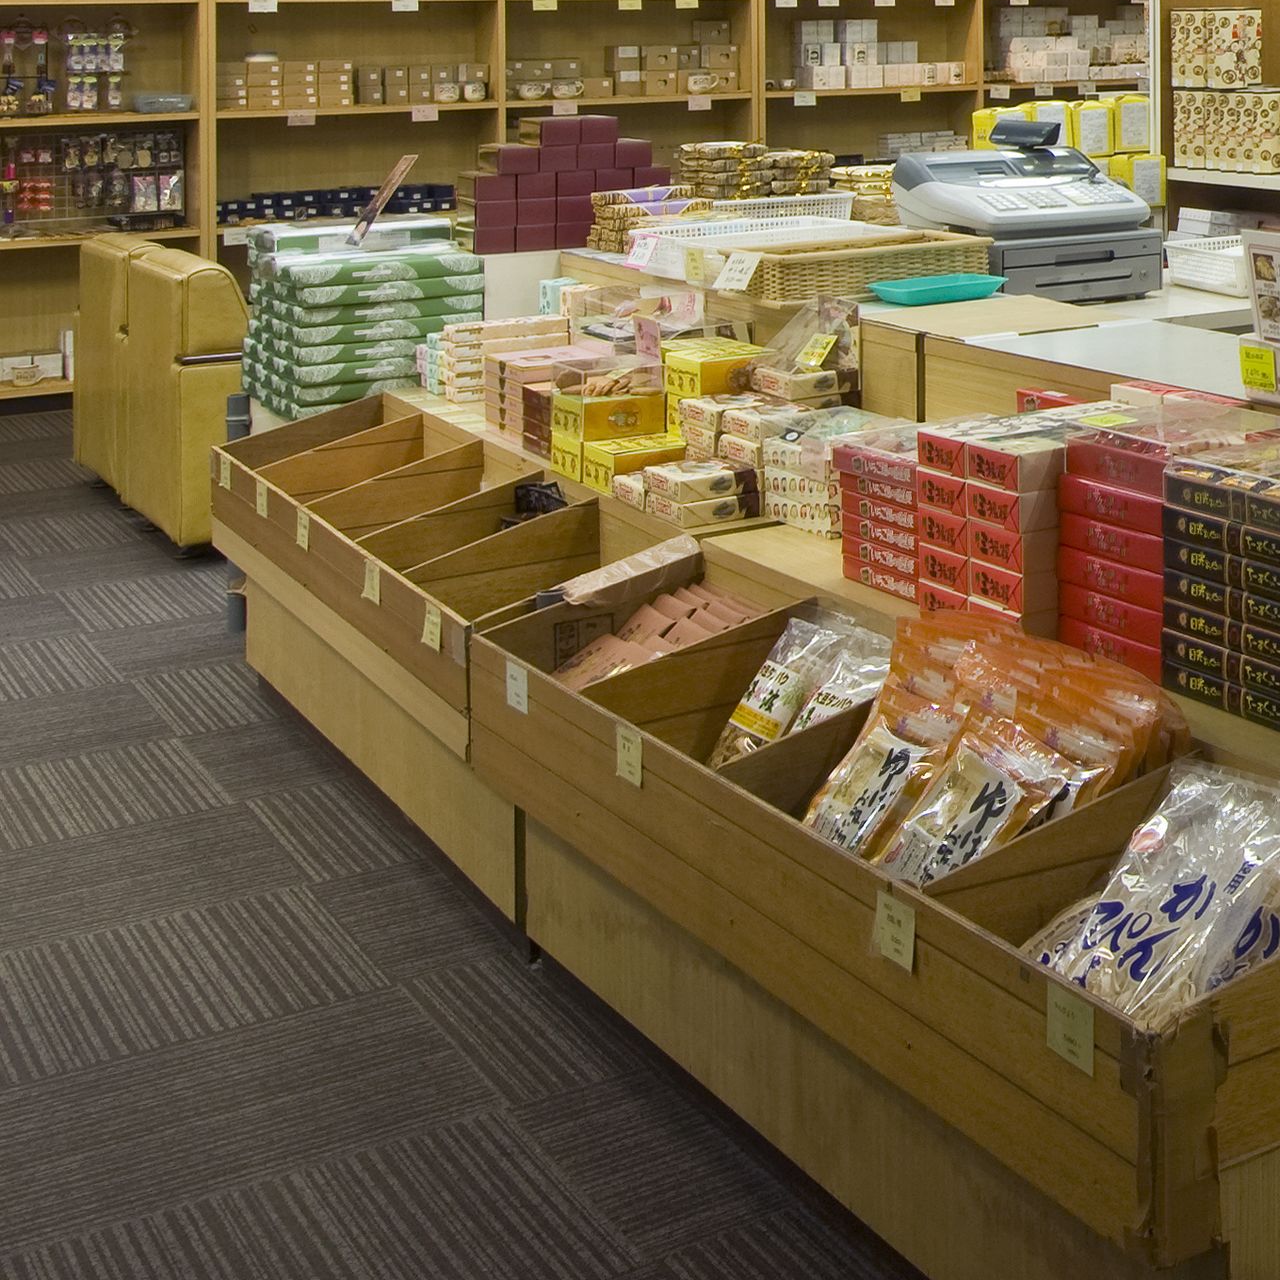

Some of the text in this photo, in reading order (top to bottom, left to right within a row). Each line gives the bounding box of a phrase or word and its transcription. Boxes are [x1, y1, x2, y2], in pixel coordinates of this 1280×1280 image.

[815, 690, 854, 710] 大豆タンパク
